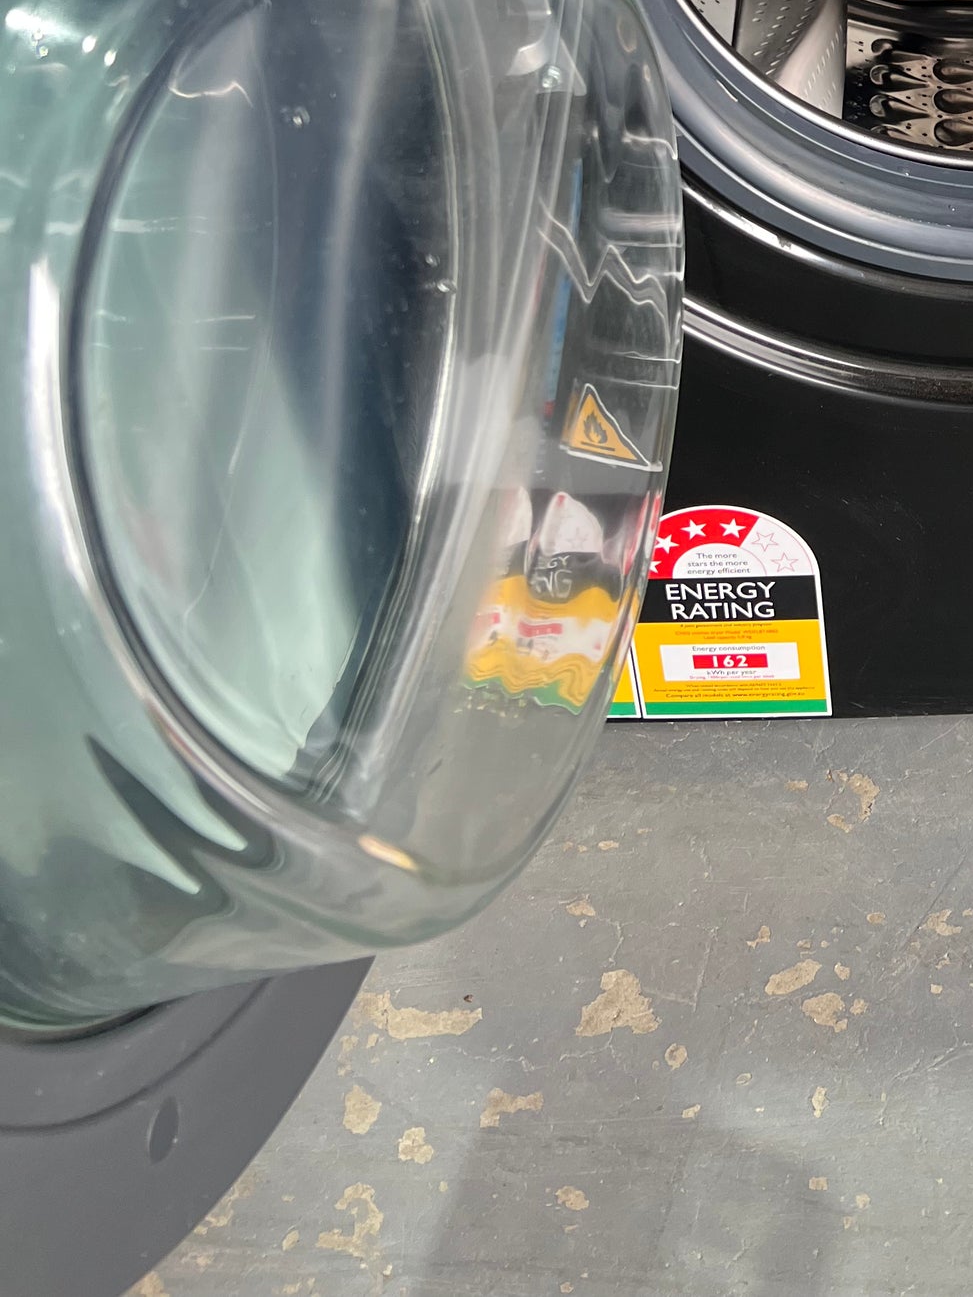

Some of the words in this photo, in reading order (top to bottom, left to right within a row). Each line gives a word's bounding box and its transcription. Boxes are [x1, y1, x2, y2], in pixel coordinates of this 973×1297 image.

[665, 581, 776, 600] ENERGY
[671, 601, 775, 620] RATING
[712, 655, 748, 667] 162
